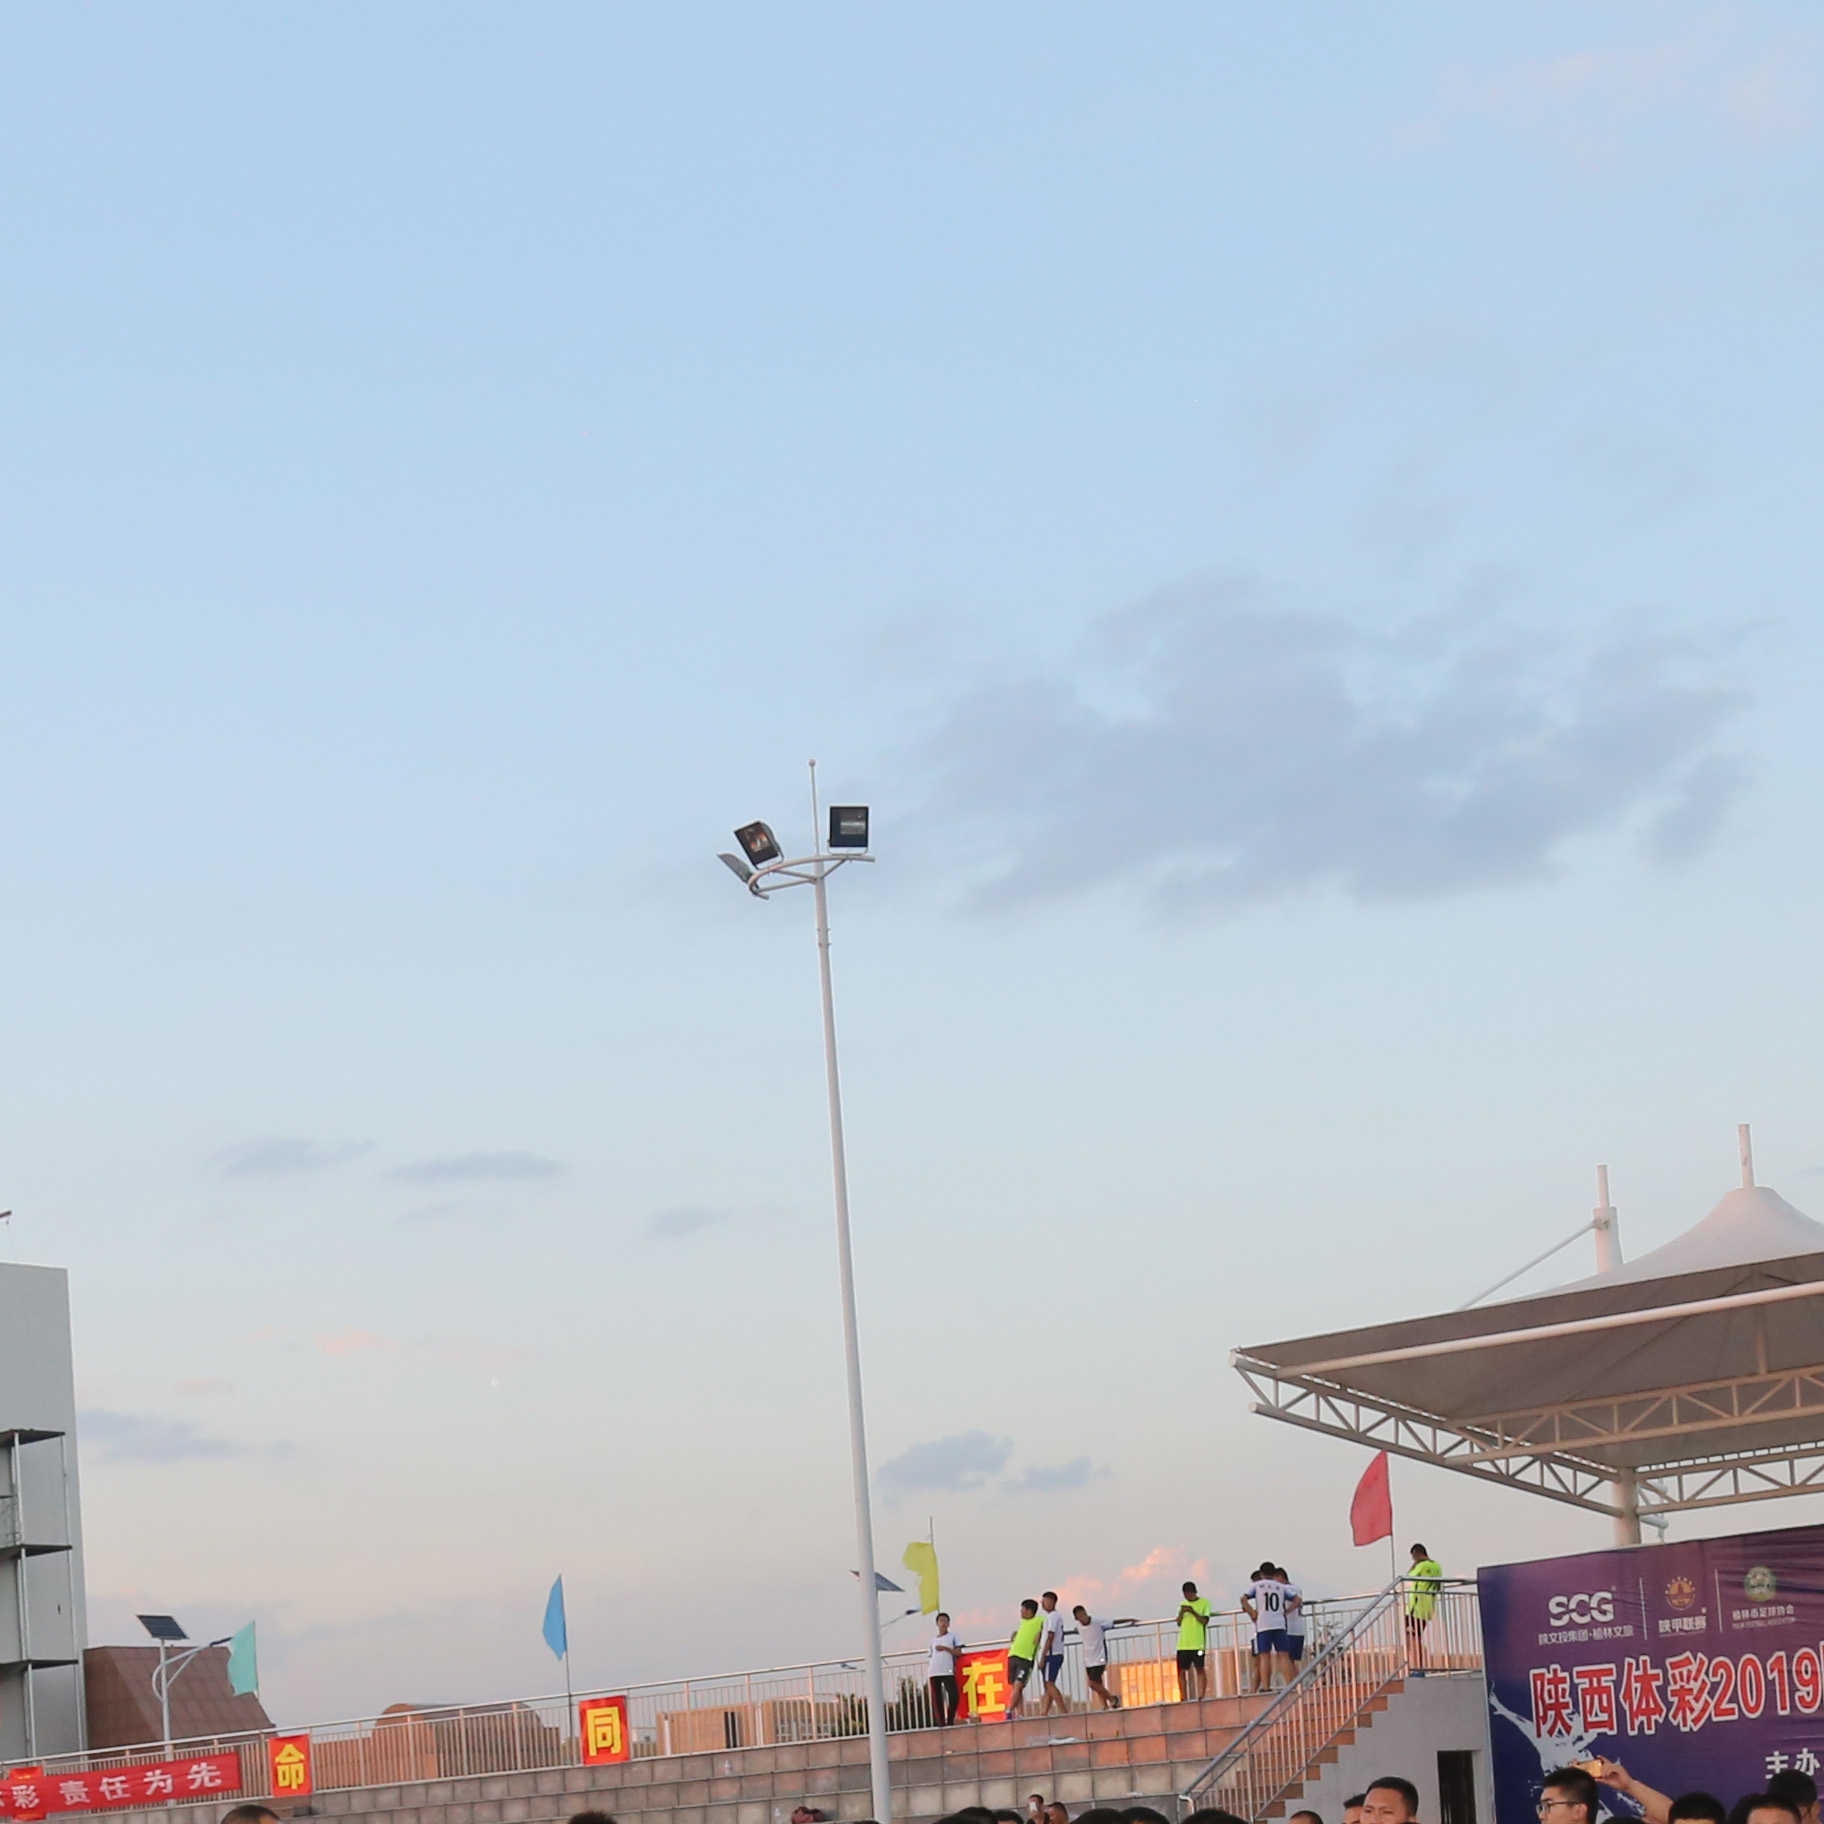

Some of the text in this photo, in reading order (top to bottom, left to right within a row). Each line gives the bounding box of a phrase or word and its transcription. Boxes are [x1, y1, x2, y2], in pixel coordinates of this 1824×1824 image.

[1263, 1591, 1280, 1612] 10
[1548, 1590, 1614, 1627] SCG
[962, 1661, 1006, 1715] 在
[586, 1706, 622, 1756] 同
[58, 1761, 223, 1806] 责任为先
[274, 1743, 306, 1791] 命
